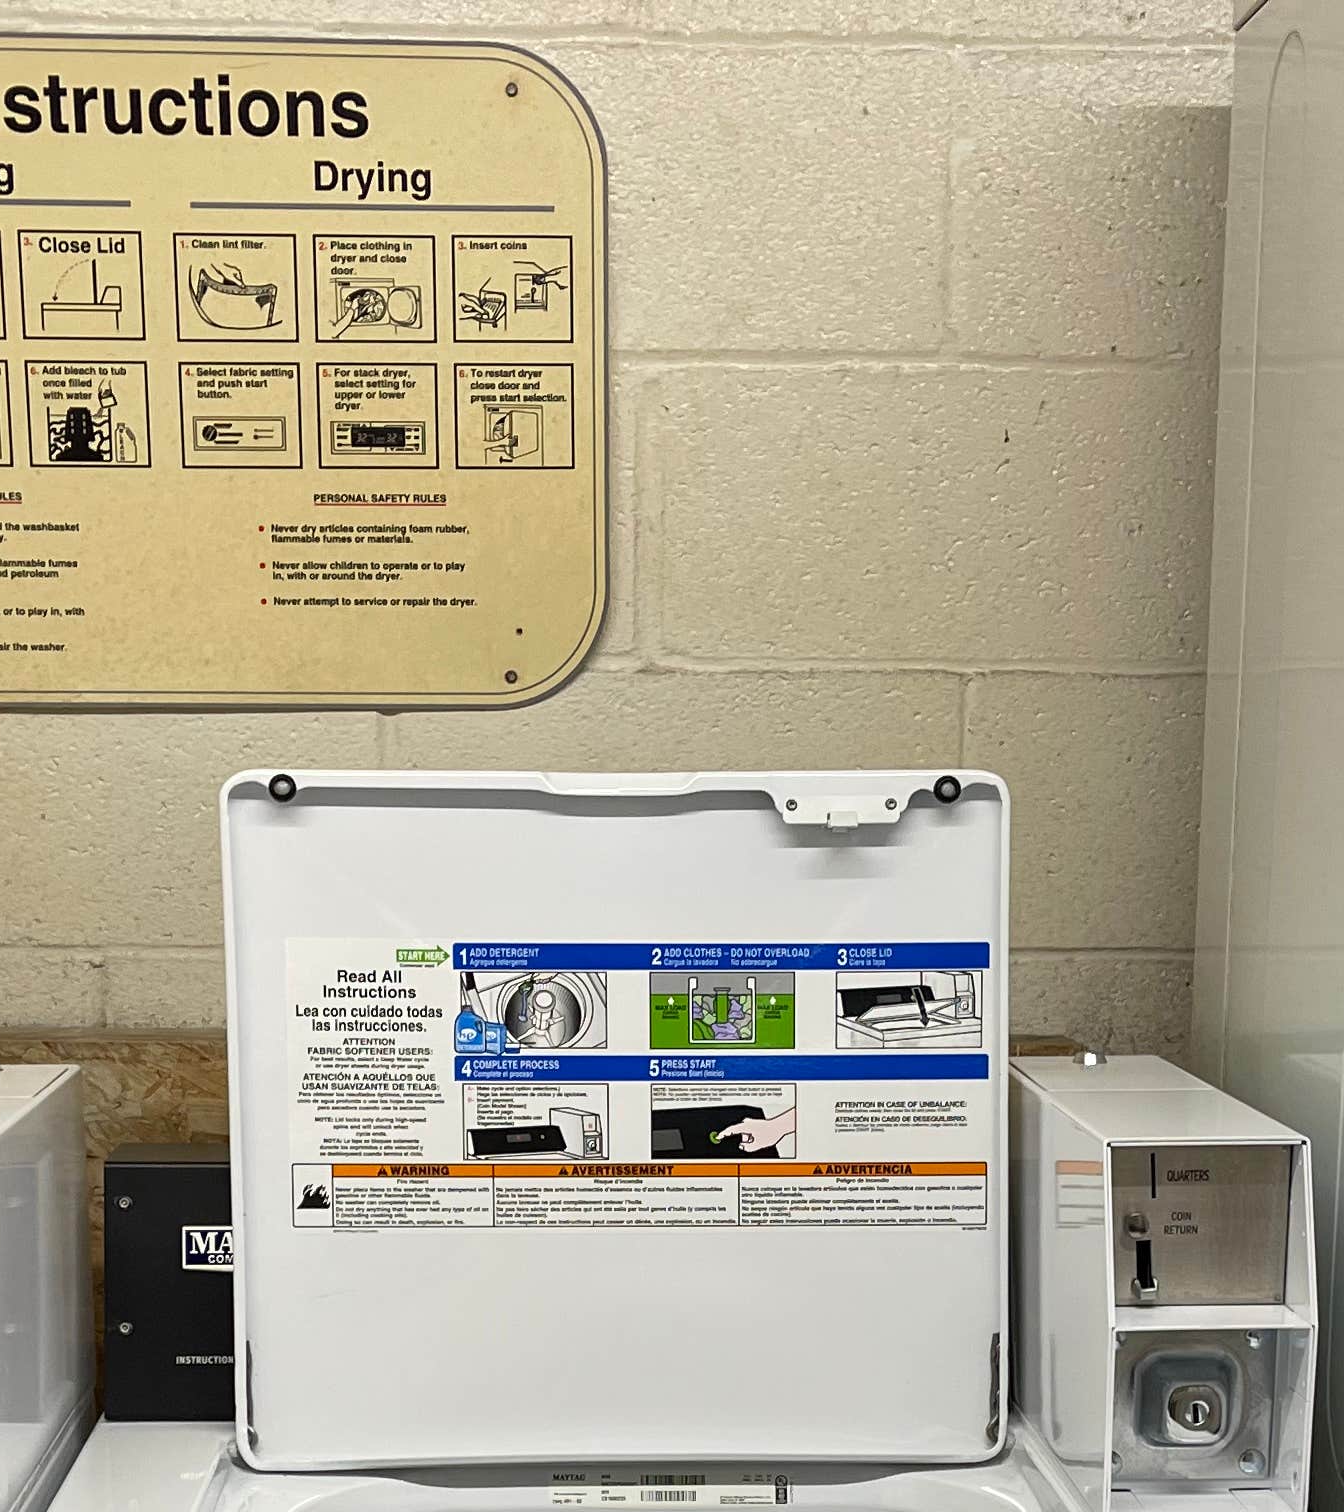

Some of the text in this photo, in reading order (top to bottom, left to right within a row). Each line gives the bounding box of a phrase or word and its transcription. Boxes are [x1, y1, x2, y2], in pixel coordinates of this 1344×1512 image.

[314, 160, 432, 200] Drying
[38, 237, 91, 254] Close
[97, 238, 125, 254] Lid
[192, 240, 219, 250] Clean
[222, 240, 239, 250] lint
[241, 240, 266, 250] filter.
[330, 241, 356, 251] Place
[360, 241, 399, 254] clothing
[403, 242, 412, 251] in
[469, 241, 498, 251] Insert
[501, 241, 527, 251] coins
[330, 254, 407, 267] dryer and close
[331, 266, 357, 276] door.
[42, 366, 61, 375] Add
[64, 366, 96, 376] bleach
[99, 367, 108, 376] to
[111, 366, 127, 376] tub
[197, 368, 227, 378] Select
[229, 368, 257, 378] fabric
[260, 368, 294, 381] setting
[334, 368, 351, 378] For
[353, 368, 379, 378] stack
[382, 368, 411, 381] dryer,
[471, 369, 482, 378] To
[485, 370, 514, 379] restart
[517, 369, 543, 381] dryer
[43, 378, 92, 389] once filled
[197, 379, 268, 391] and push start
[334, 379, 416, 392] select setting for
[471, 381, 540, 391] close door and
[43, 391, 92, 401] with water
[197, 390, 232, 400] button.
[335, 390, 406, 402] upper or lower
[471, 393, 567, 404] press start selection.
[335, 401, 362, 412] dryer.
[313, 494, 447, 503] PERSONAL SAFETY RULES
[459, 948, 540, 965] 1 ADD DETERGENT
[652, 948, 810, 965] 2 ADD CLOTHES DO NOT OVERLOAD
[838, 948, 893, 966] 3 CLOSE LID
[337, 970, 402, 983] Read All
[323, 985, 416, 999] Instructions
[296, 1005, 443, 1018] Lea con cuidado todas
[312, 1019, 427, 1033] las instrucciones.
[461, 1060, 560, 1077] 4 COMPLETE PROCESS
[649, 1060, 716, 1077] 5 PRESS START
[391, 1166, 449, 1176] WARNING
[572, 1165, 674, 1176] AVERTISSEMENT
[826, 1164, 912, 1175] ADVERTENCIA
[1166, 1169, 1210, 1182] QUARTERS
[1171, 1211, 1192, 1221] COIN
[1163, 1225, 1199, 1235] RETURN
